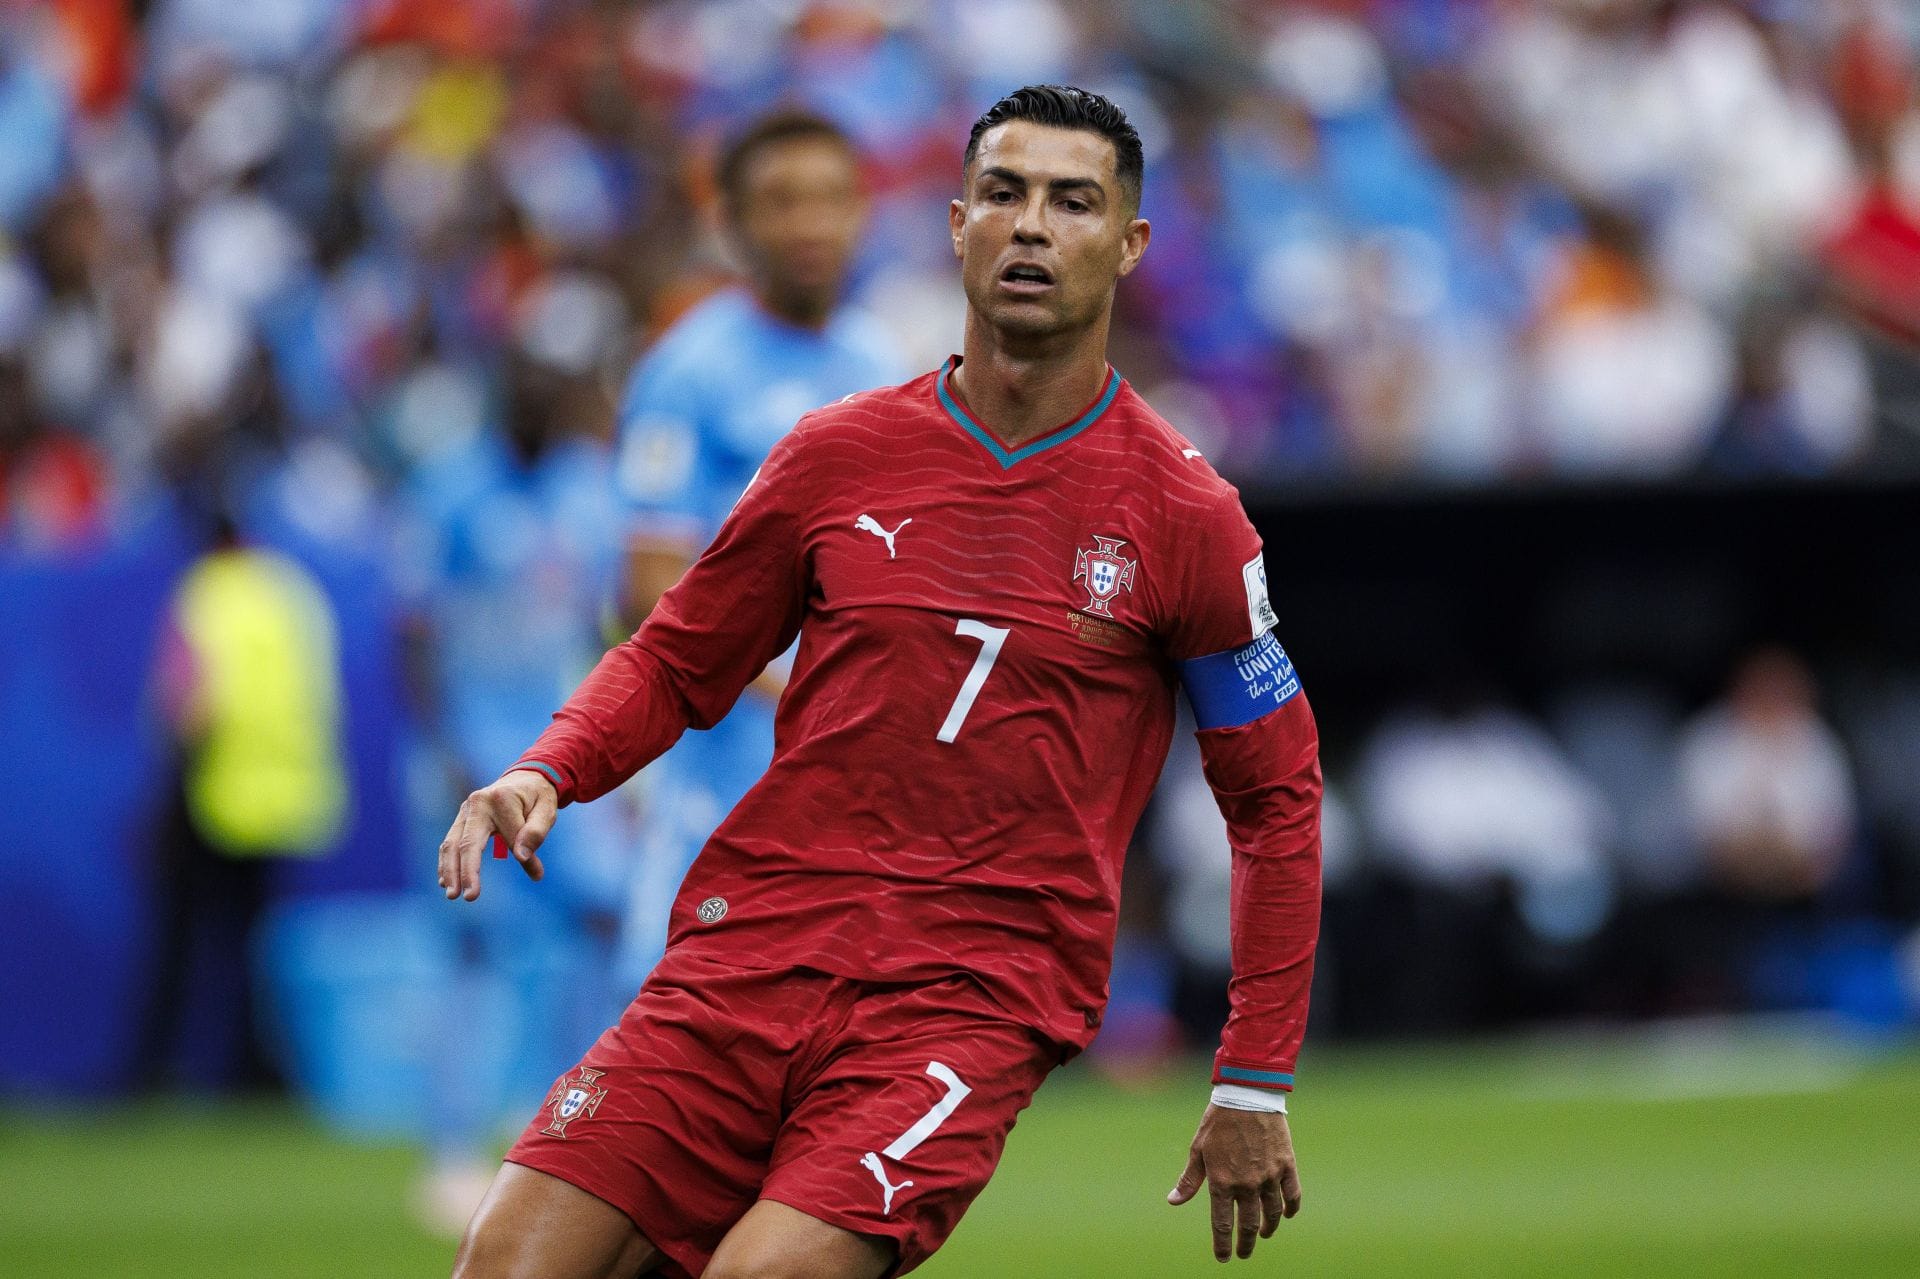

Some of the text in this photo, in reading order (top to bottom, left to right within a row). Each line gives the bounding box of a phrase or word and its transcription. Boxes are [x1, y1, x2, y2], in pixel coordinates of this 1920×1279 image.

[1066, 612, 1102, 627] PORTUGAL
[1071, 622, 1079, 631] 17
[936, 619, 1011, 743] 7
[1245, 680, 1273, 699] the
[1276, 680, 1297, 701] FIFA
[881, 1061, 973, 1161] 7
